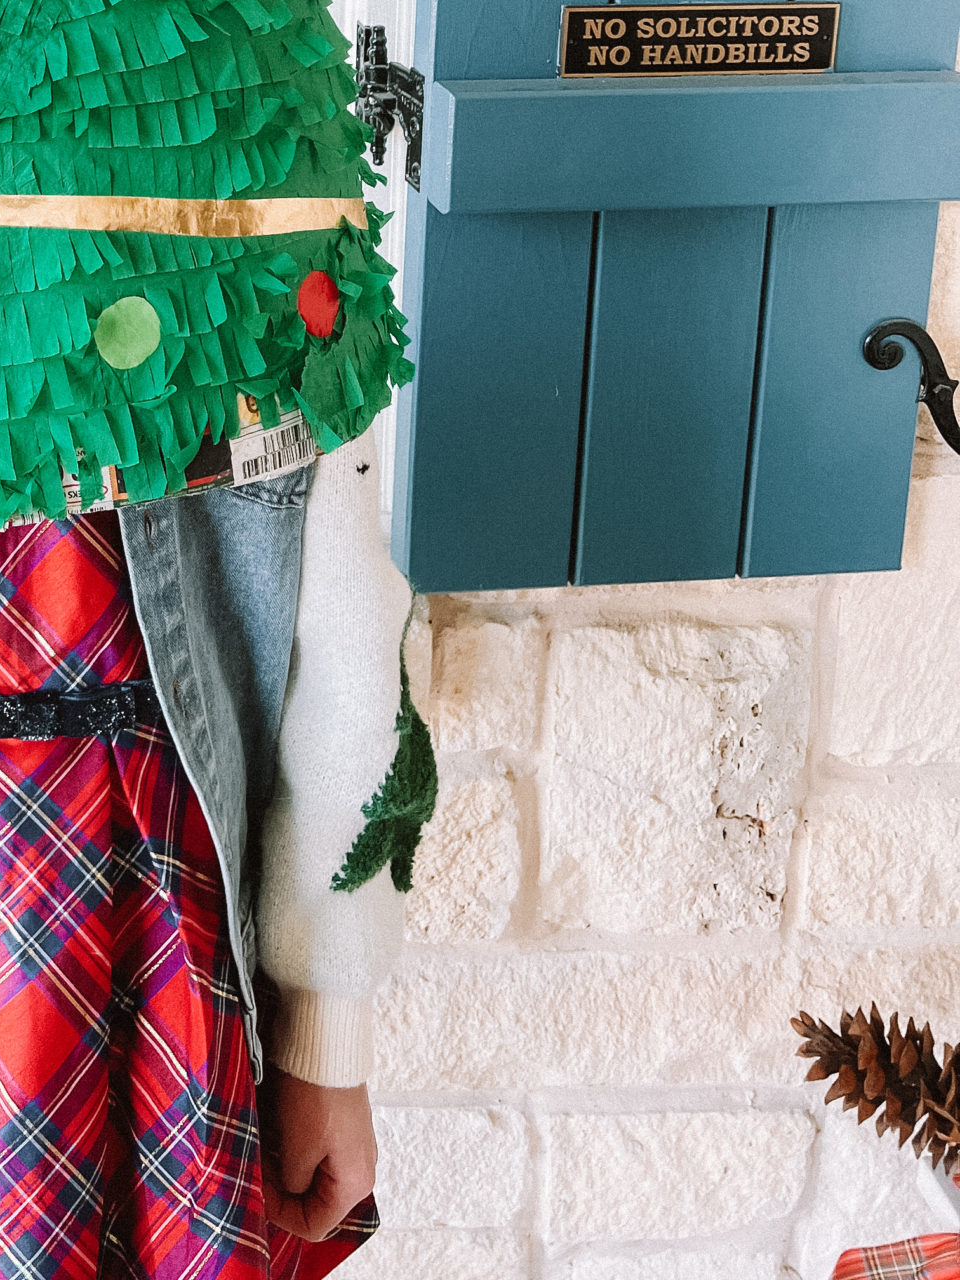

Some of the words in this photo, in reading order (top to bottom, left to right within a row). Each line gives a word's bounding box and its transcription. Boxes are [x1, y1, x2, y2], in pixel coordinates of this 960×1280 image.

[583, 18, 626, 39] NO
[636, 15, 819, 38] SOLICITORS
[587, 45, 631, 66] NO
[640, 42, 810, 65] HANDBILLS
